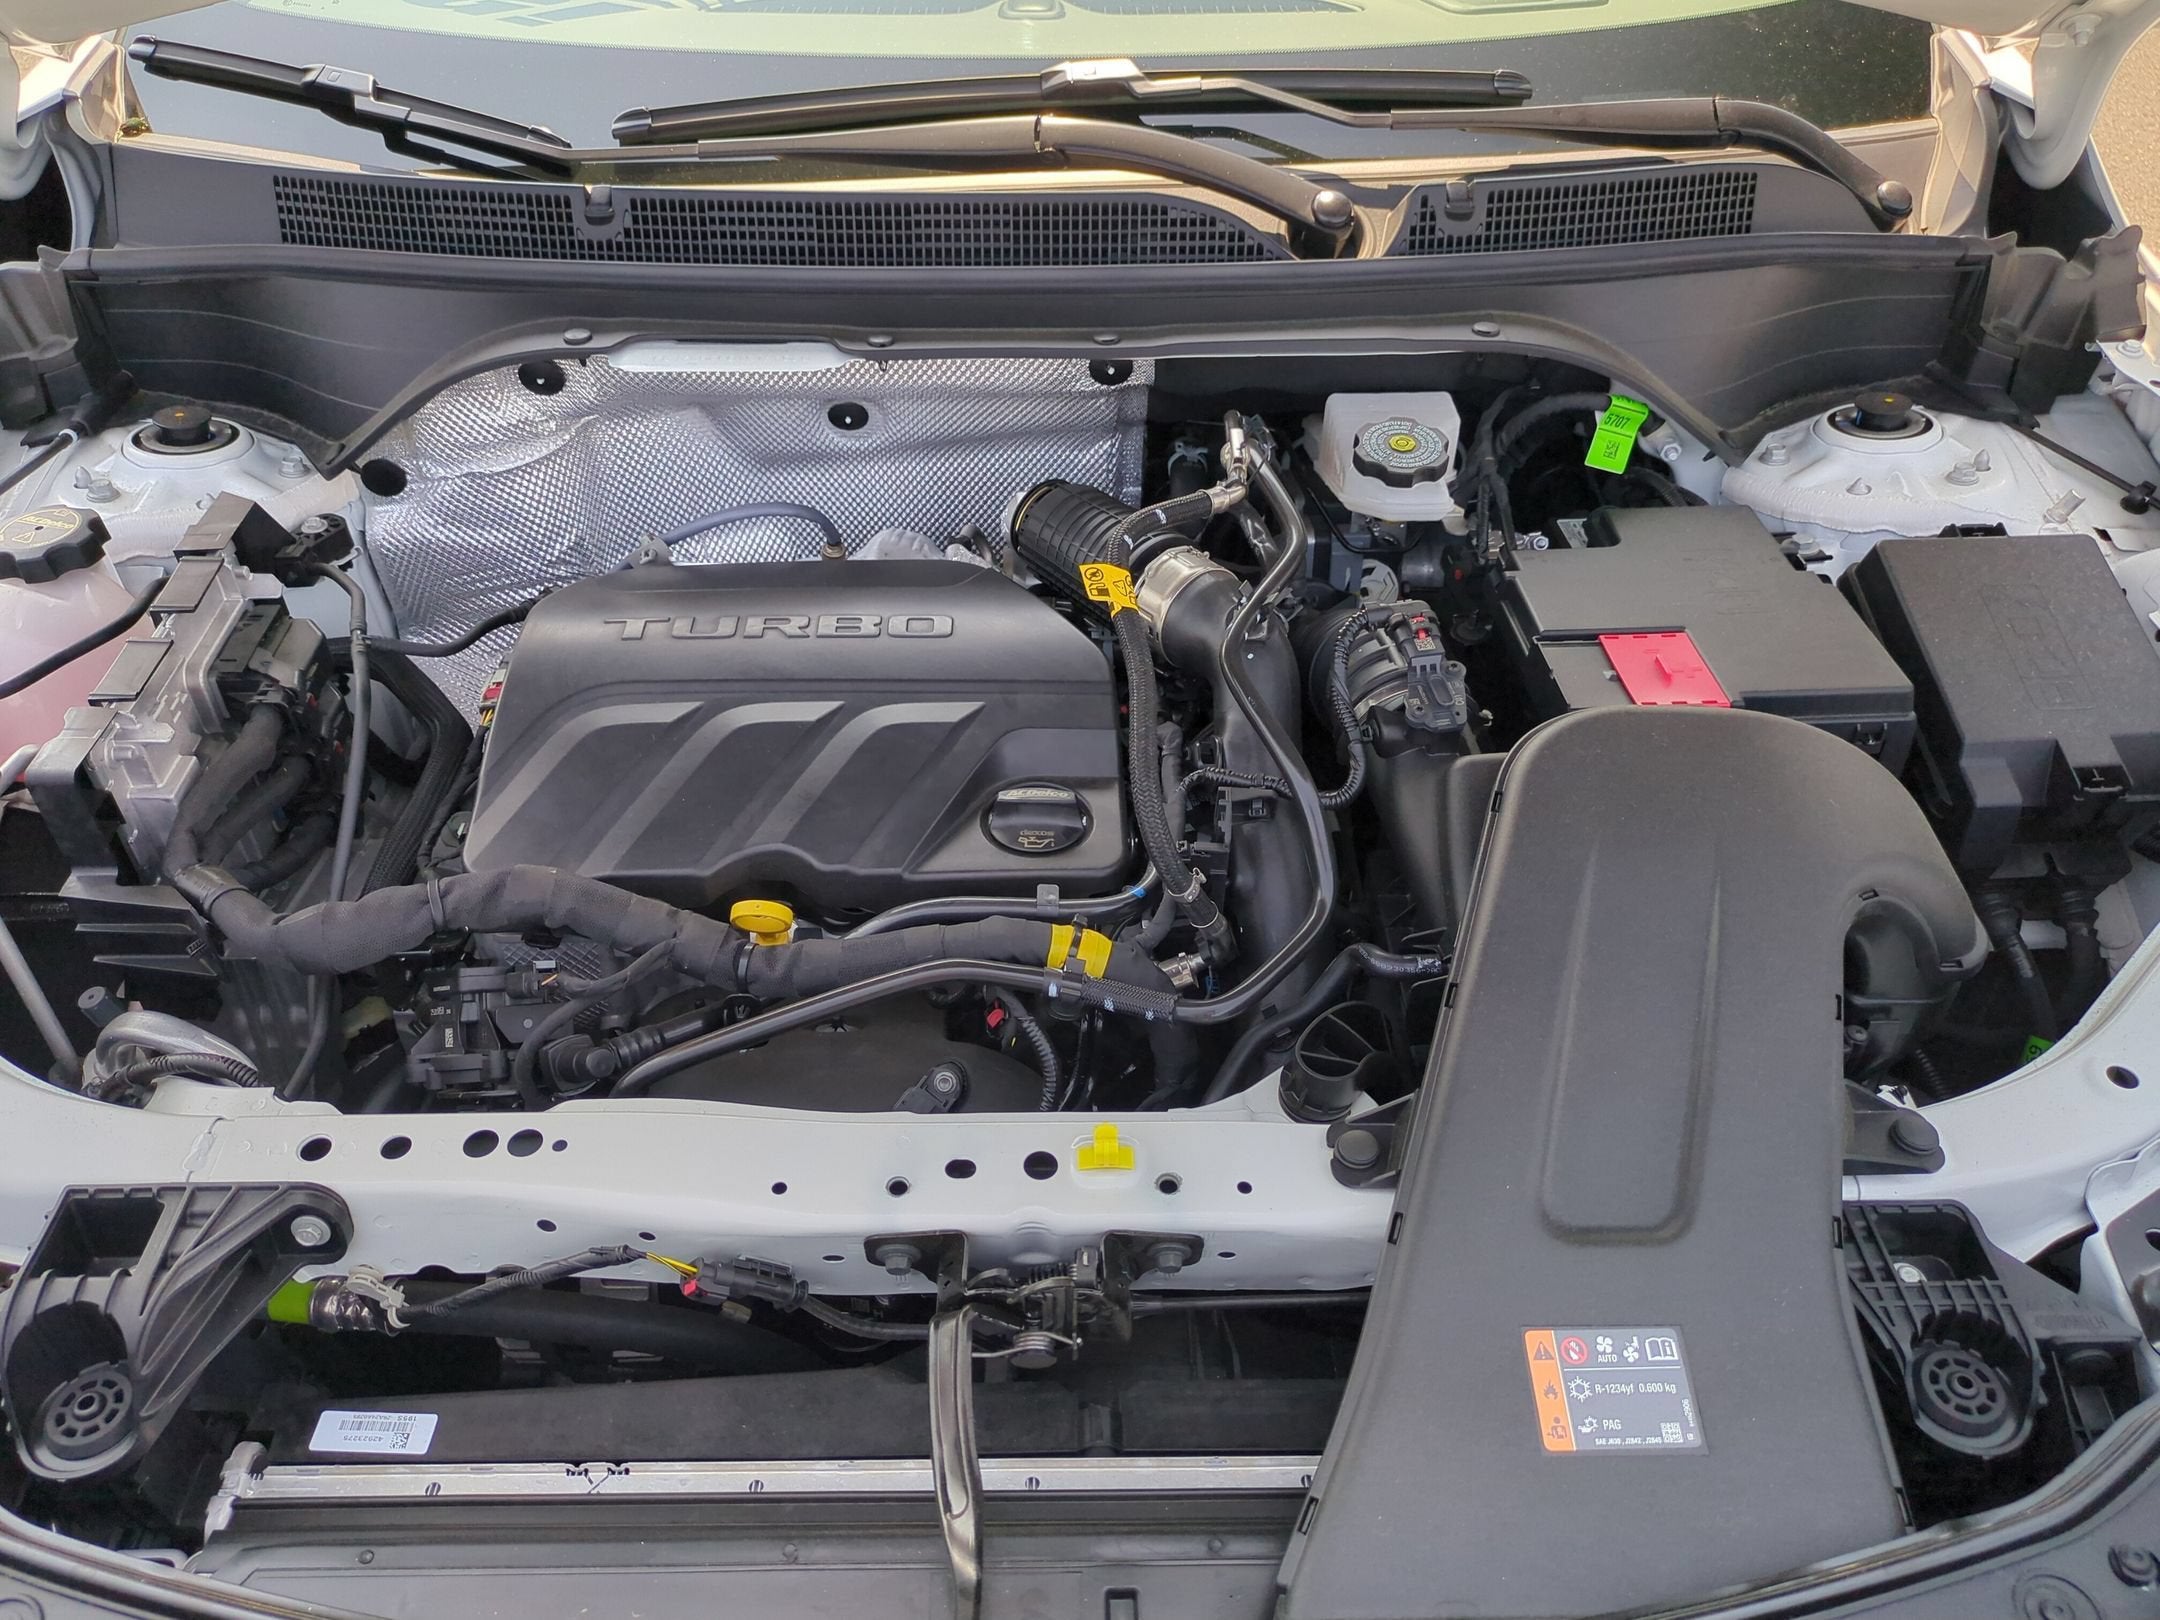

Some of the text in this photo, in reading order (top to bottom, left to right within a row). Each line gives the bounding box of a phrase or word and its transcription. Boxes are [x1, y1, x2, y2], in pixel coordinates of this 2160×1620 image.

[604, 615, 955, 640] TURBO
[1597, 1354, 1618, 1363] AUTO
[1594, 1382, 1676, 1395] R-1234yf 0.600 kg
[1602, 1419, 1622, 1431] PAG
